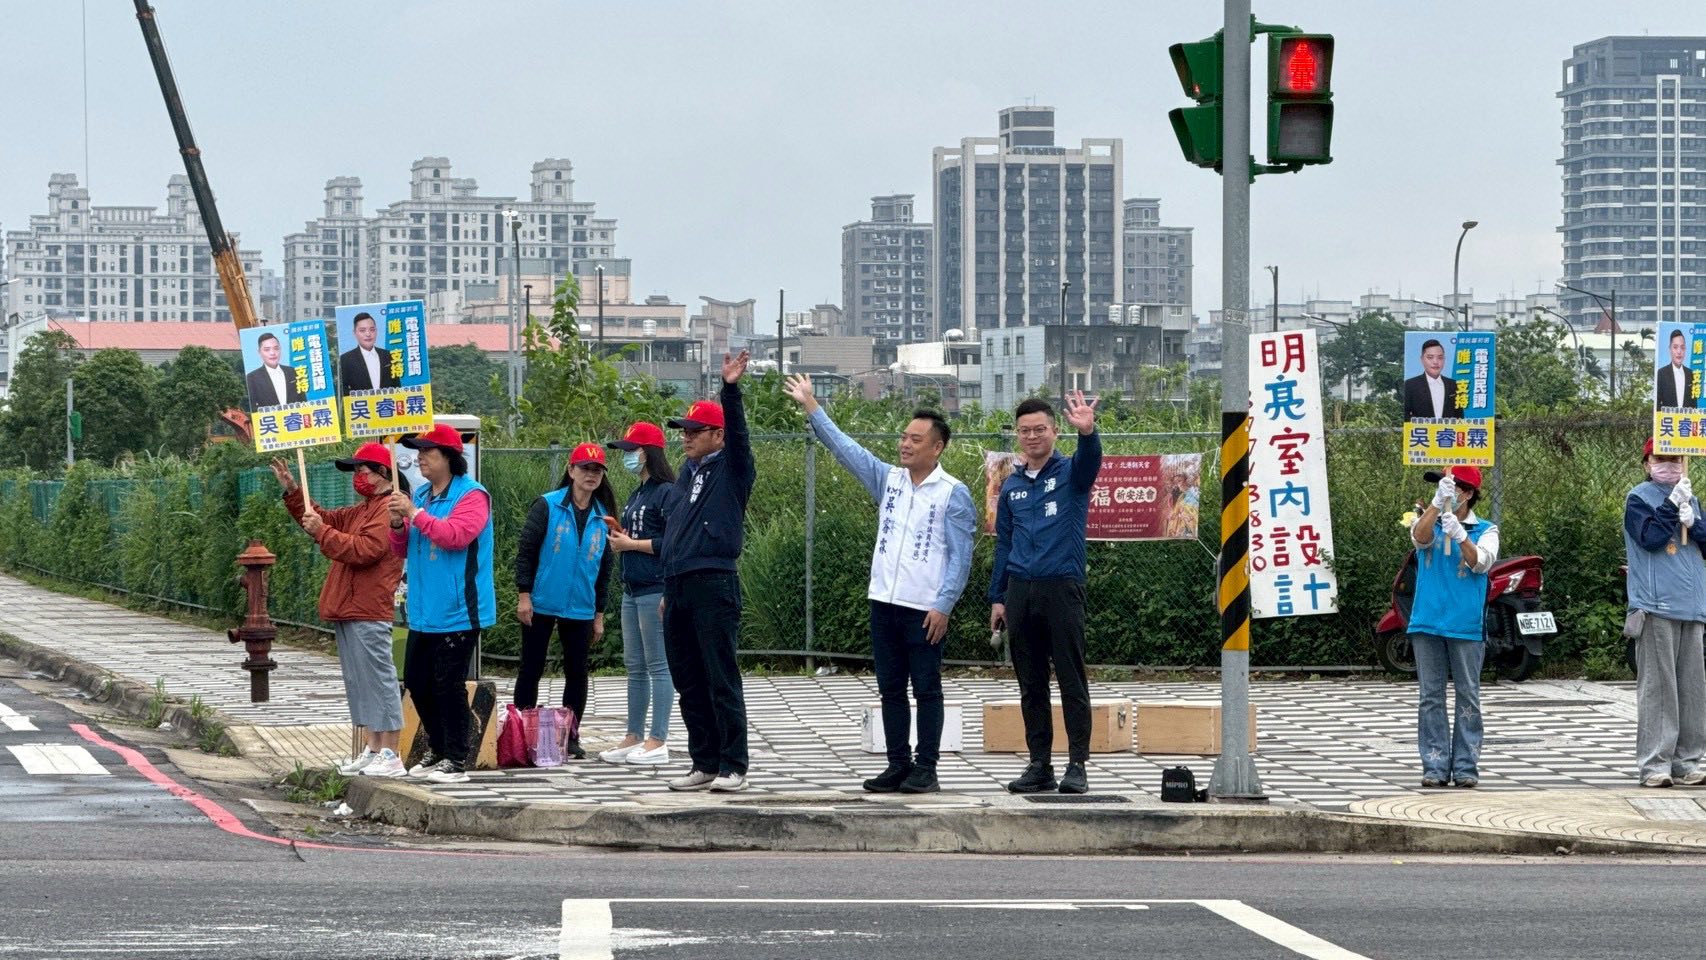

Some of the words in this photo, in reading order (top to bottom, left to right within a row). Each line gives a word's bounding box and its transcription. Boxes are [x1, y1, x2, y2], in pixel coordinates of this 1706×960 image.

[291, 336, 309, 394] 唯一支持
[308, 334, 326, 391] 電話民調
[388, 318, 404, 379] 唯一支持
[405, 316, 422, 376] 電話民調
[1455, 348, 1472, 409] 唯一支持
[1472, 348, 1488, 409] 電話民調
[1691, 339, 1703, 399] 唯一支持
[259, 408, 333, 435] 吳睿霖
[351, 395, 426, 420] 吳睿霖
[586, 447, 600, 459] W
[1409, 428, 1488, 448] 吳睿霖
[1120, 461, 1150, 469] 北港朝天宮
[1261, 334, 1331, 615] 明亮室內設計
[1010, 490, 1028, 501] tao
[1090, 485, 1111, 507] 福
[1520, 617, 1554, 630] NBE-7121
